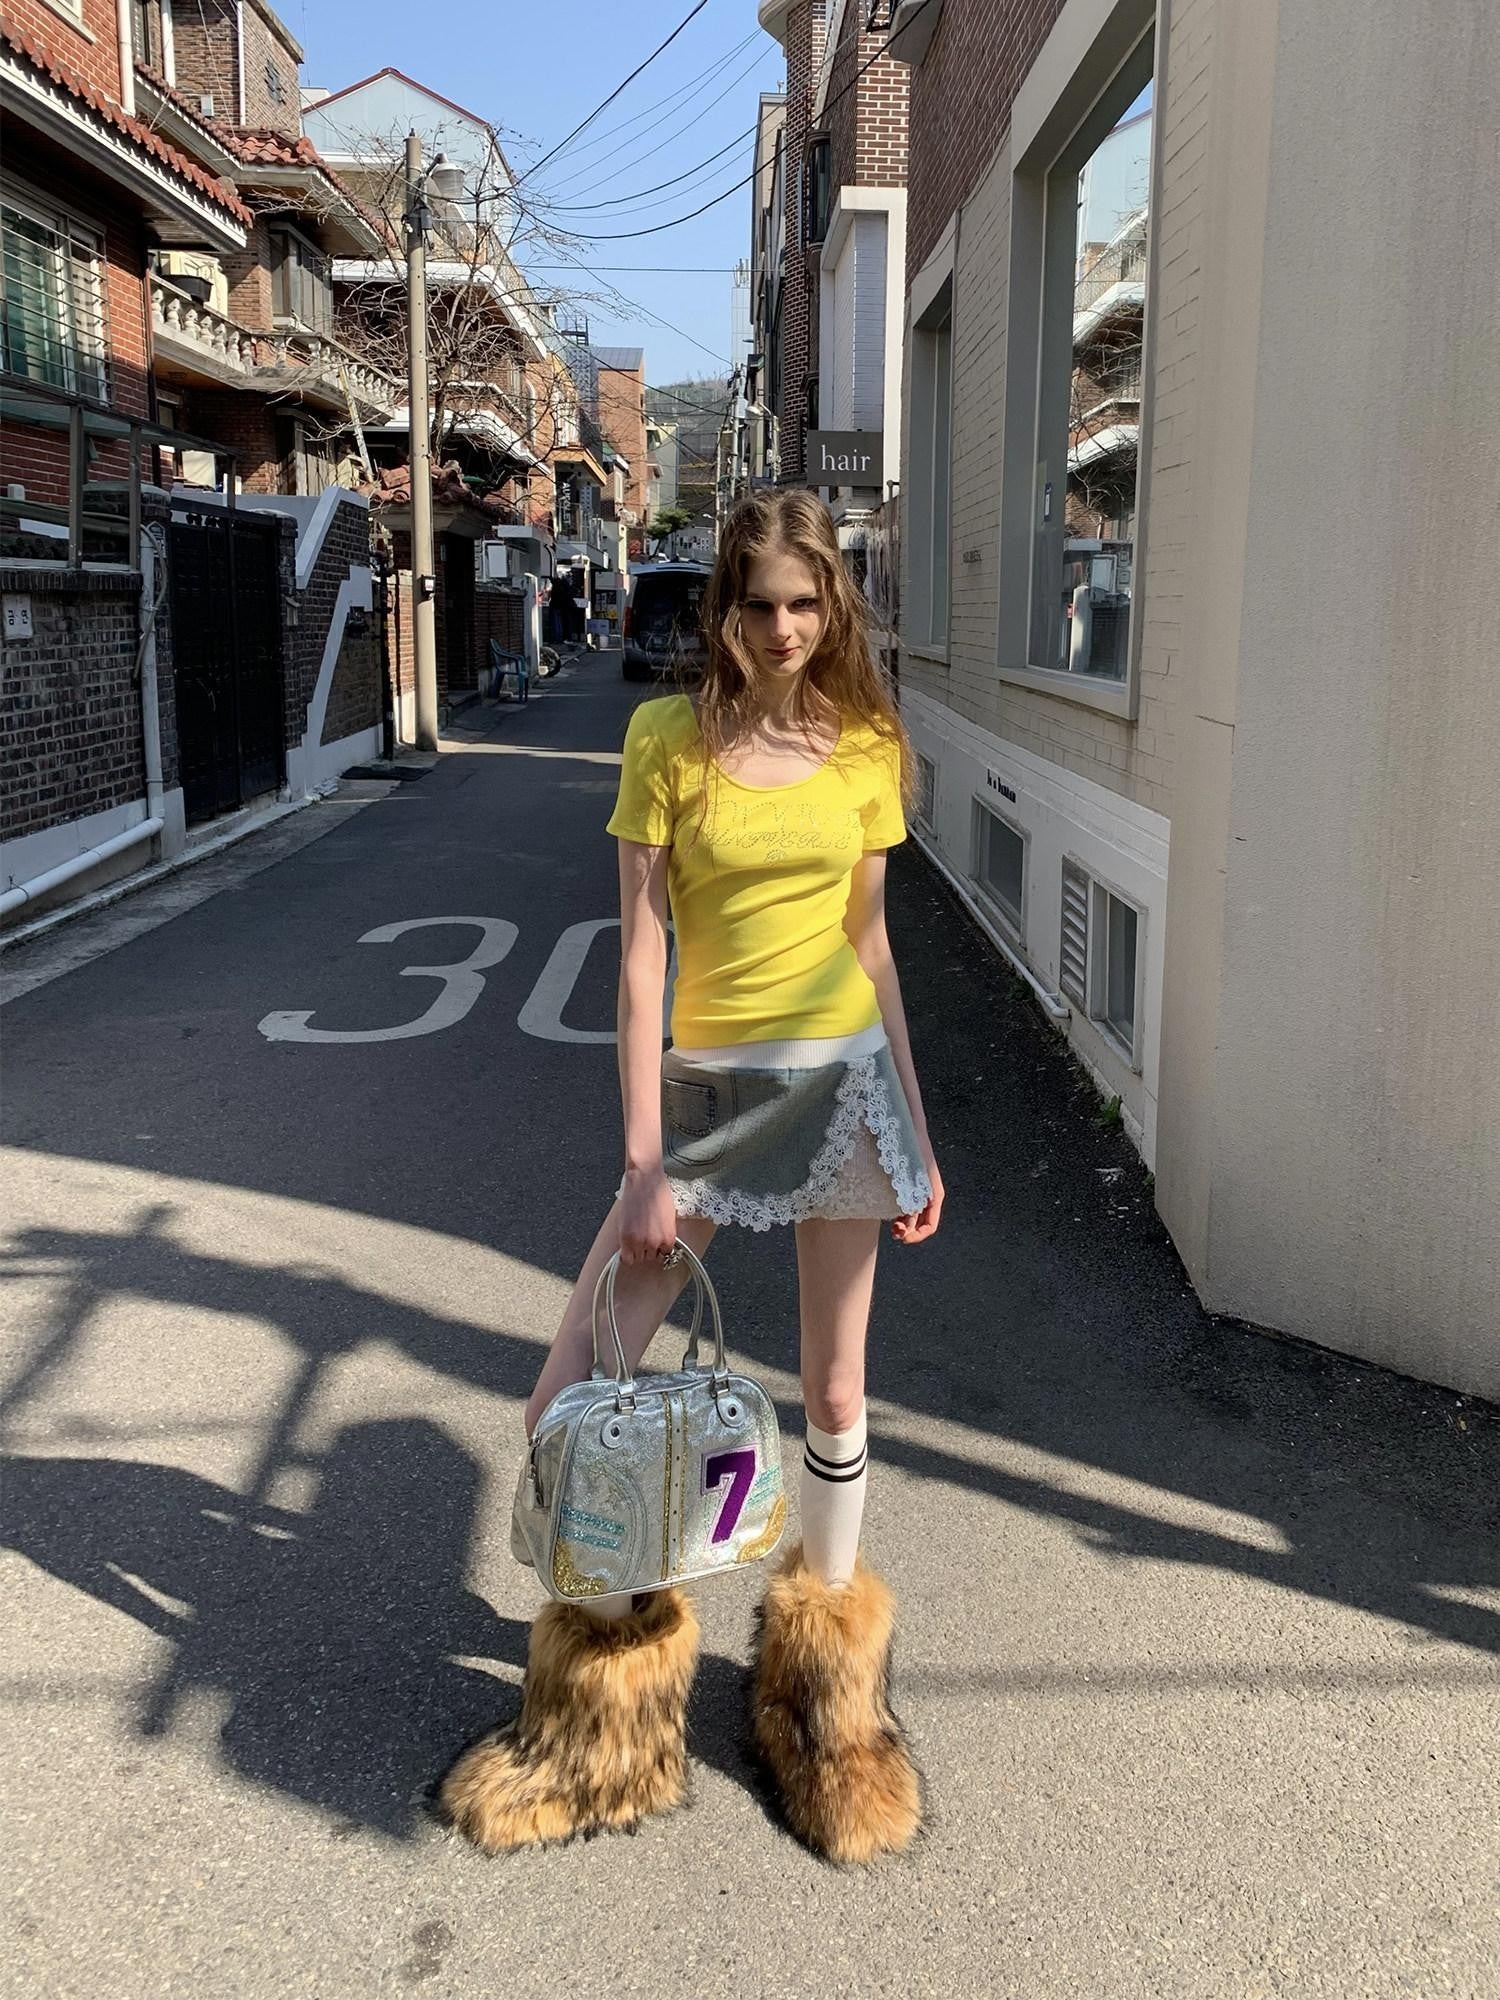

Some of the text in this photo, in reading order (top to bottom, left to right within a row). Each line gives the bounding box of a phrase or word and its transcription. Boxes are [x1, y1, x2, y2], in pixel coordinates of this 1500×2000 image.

[821, 444, 871, 471] hair
[257, 916, 678, 1043] 30
[701, 1445, 758, 1547] 7
